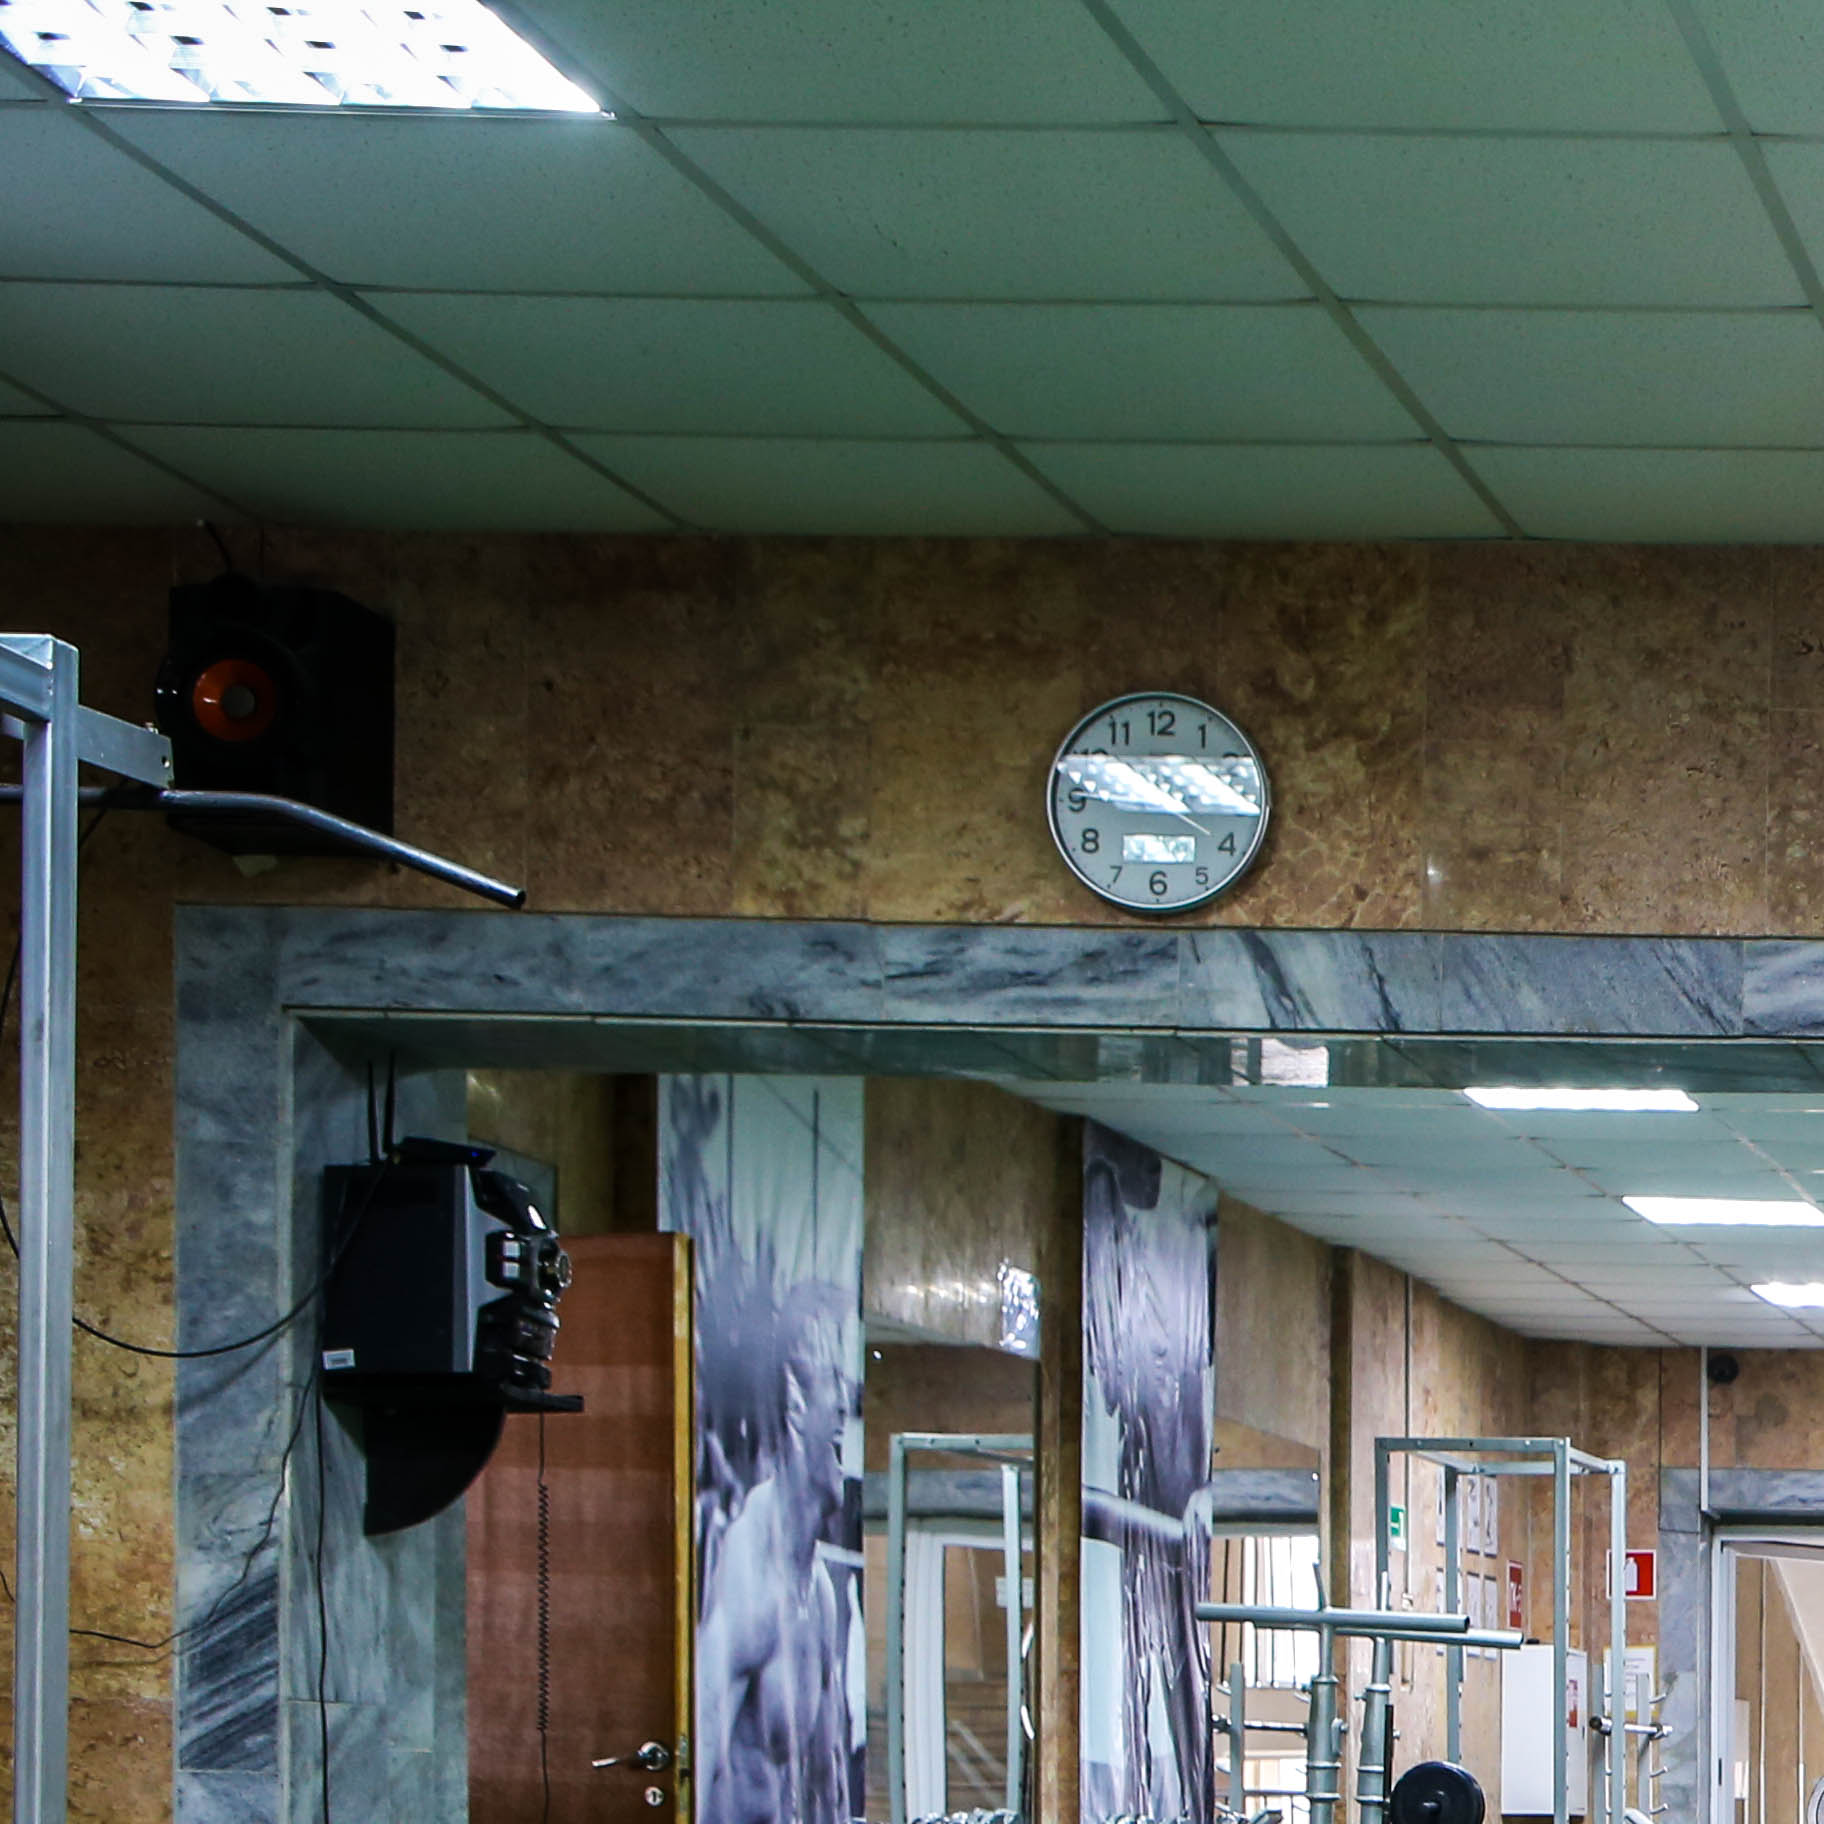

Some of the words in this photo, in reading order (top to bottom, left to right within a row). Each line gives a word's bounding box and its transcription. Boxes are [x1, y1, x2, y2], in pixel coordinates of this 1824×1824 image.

[1109, 721, 1130, 745] 11
[1147, 711, 1176, 737] 12
[1198, 724, 1207, 748] 1
[1068, 788, 1087, 812] 9
[1081, 828, 1099, 853] 8
[1217, 832, 1236, 856] 4
[1110, 865, 1123, 884] 7
[1149, 871, 1168, 895] 6
[1196, 867, 1209, 885] 5
